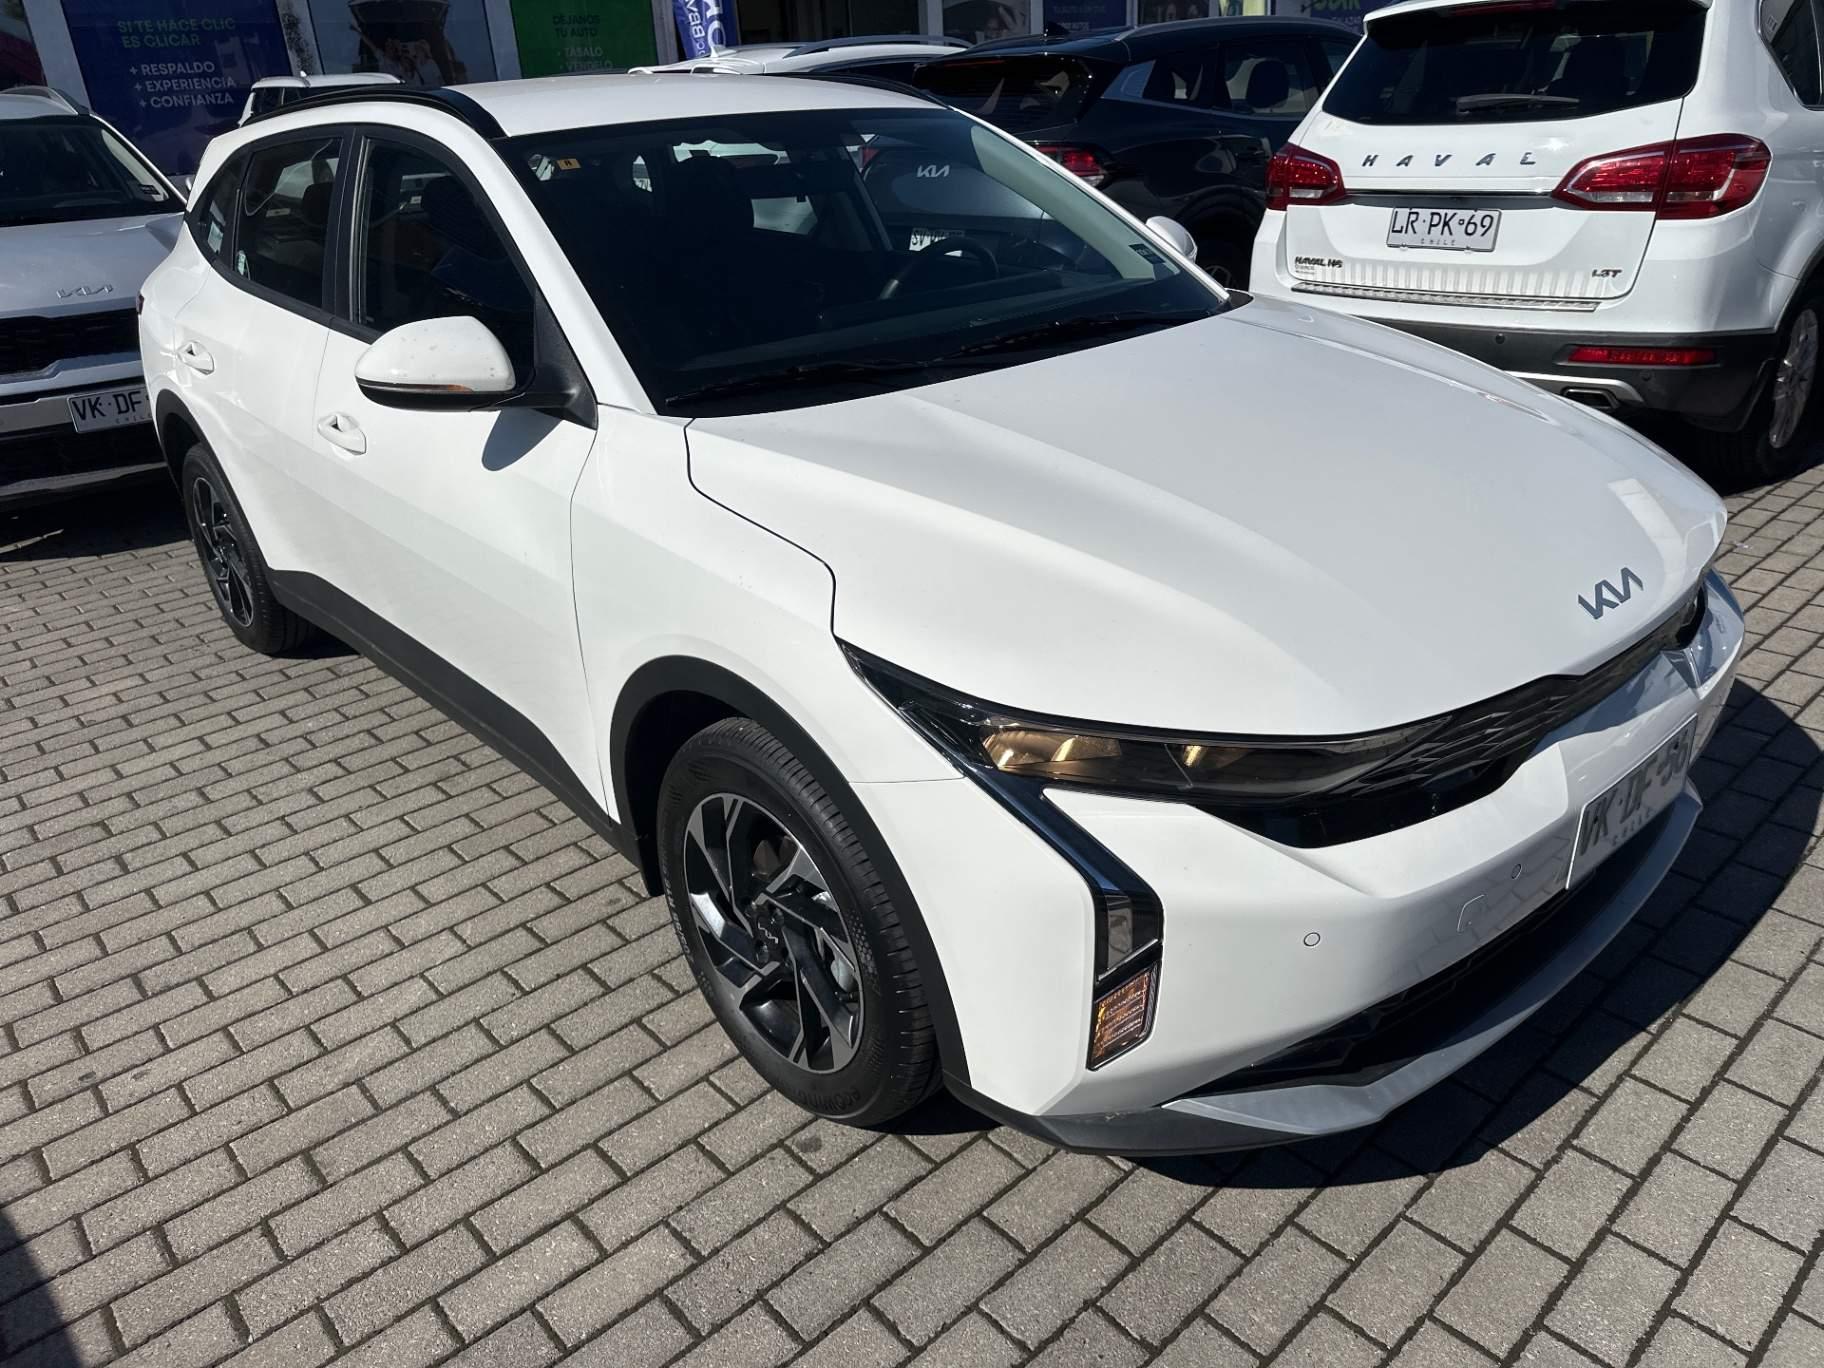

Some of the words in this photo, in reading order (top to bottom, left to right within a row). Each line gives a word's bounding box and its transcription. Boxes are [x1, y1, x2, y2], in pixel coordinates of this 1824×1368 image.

[117, 20, 133, 33] SI
[135, 20, 154, 32] TE
[157, 19, 199, 32] HACE
[201, 17, 236, 31] CLIC
[122, 35, 141, 48] ES
[144, 33, 200, 47] CLICAR
[141, 61, 216, 75] RESPALDO
[145, 76, 237, 92] EXPERIENCIA
[150, 92, 235, 108] CONFIANZA
[1361, 151, 1537, 167] HAVAL
[916, 164, 950, 178] KIA
[1577, 567, 1644, 620] KIA
